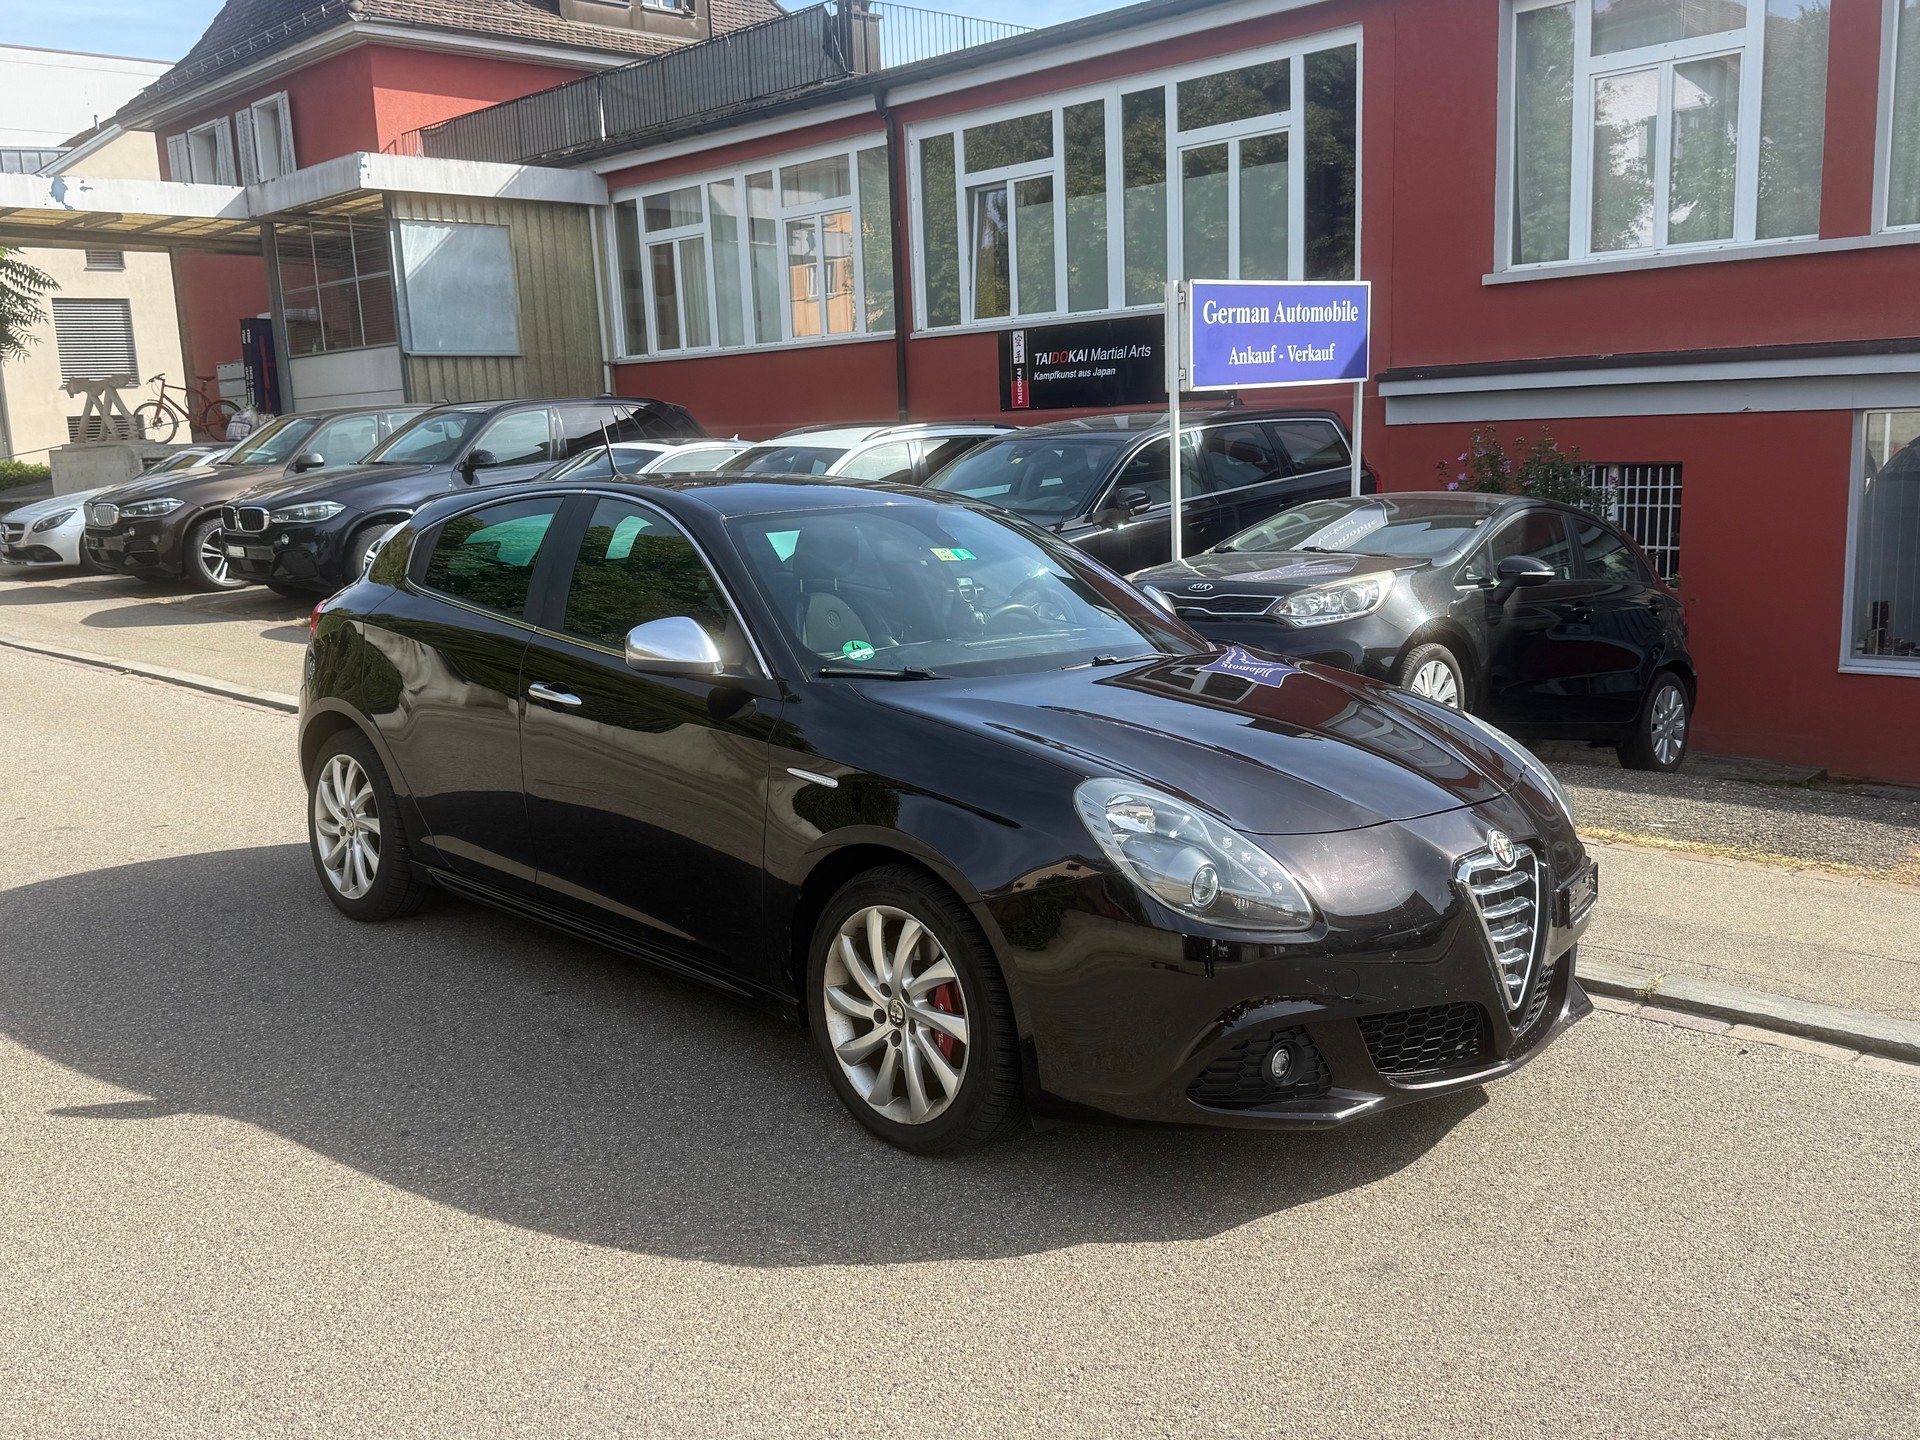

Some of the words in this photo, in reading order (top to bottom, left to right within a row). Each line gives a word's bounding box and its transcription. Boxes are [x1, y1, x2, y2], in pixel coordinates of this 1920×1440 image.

[1203, 300, 1270, 325] German
[1273, 300, 1359, 323] Automobile
[1034, 349, 1088, 366] TAIDOKAI
[1090, 345, 1128, 362] Martial
[1128, 344, 1152, 359] Arts
[1228, 345, 1277, 365] Ankauf
[1286, 343, 1336, 363] Verkauf
[1033, 369, 1077, 381] Kampfkunst
[1077, 369, 1092, 378] aus
[1092, 366, 1116, 379] Japan
[851, 641, 862, 651] 4
